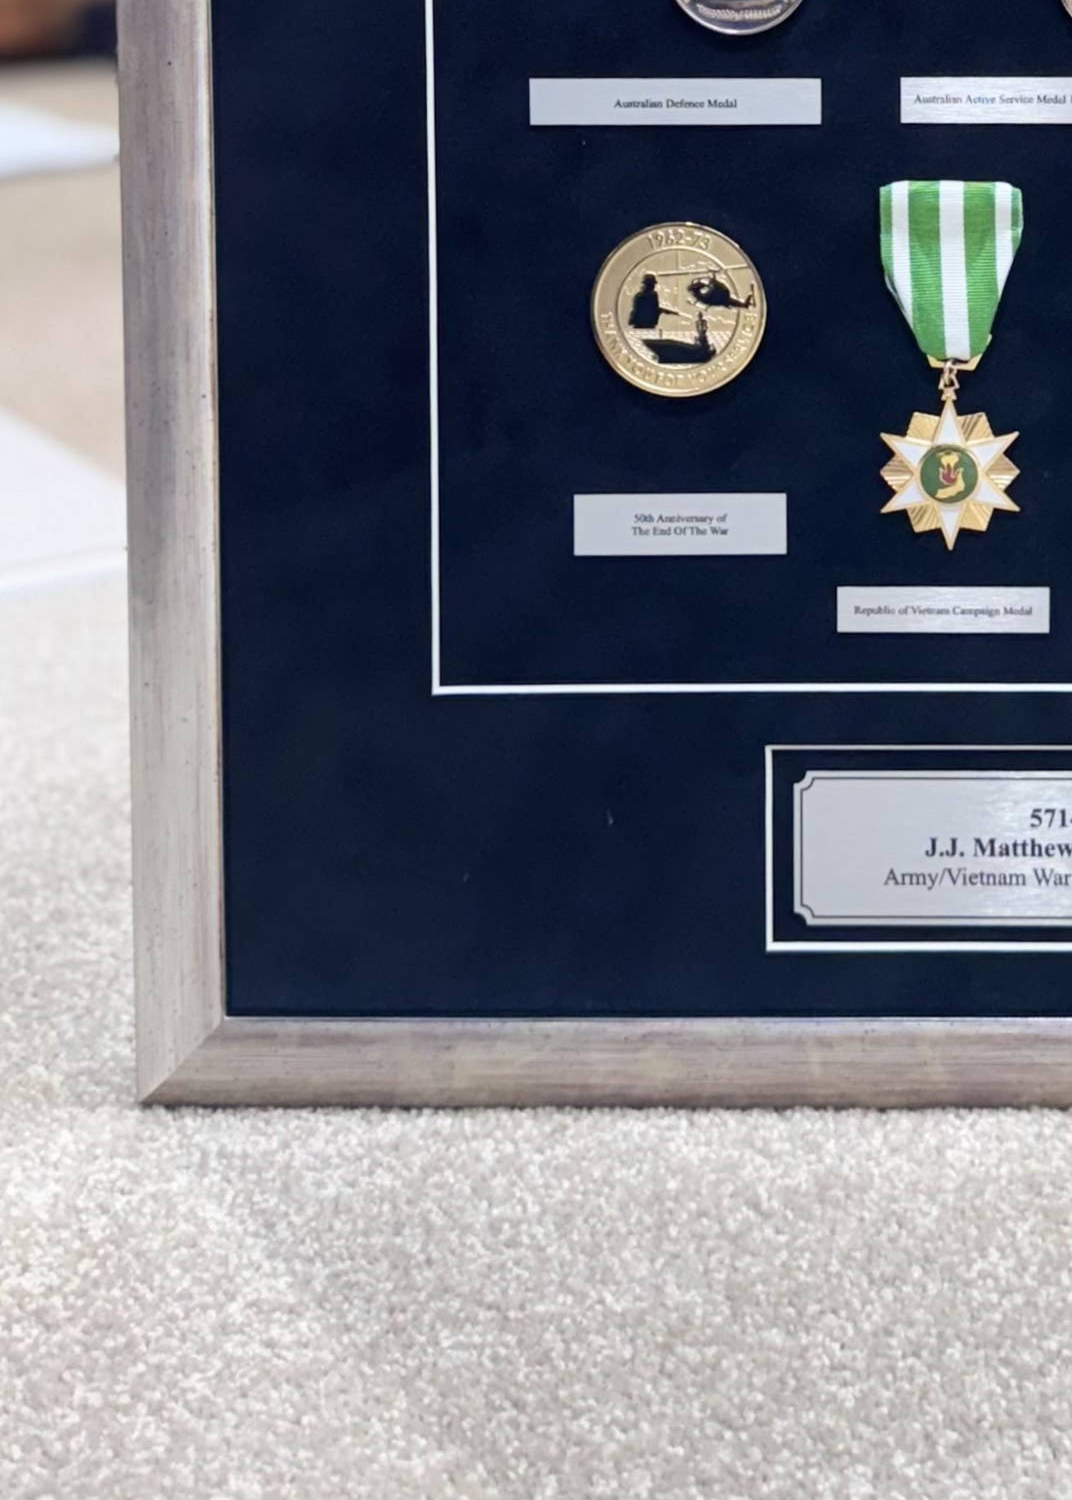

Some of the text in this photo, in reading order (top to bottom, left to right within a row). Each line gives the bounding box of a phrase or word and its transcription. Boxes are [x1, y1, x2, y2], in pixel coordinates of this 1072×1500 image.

[614, 99, 737, 109] Australian Defence Medal
[914, 95, 962, 105] Australian
[965, 95, 996, 105] Active
[999, 95, 1034, 105] Service
[1037, 95, 1066, 105] Medal
[634, 514, 727, 525] 50th Anniversary of
[632, 526, 728, 536] The End Of The War
[854, 605, 1032, 617] Republic of Vietnam Campaign Medal
[924, 837, 965, 858] J.J.
[883, 867, 1026, 892] Army/Vietnam
[1032, 867, 1070, 887] War
